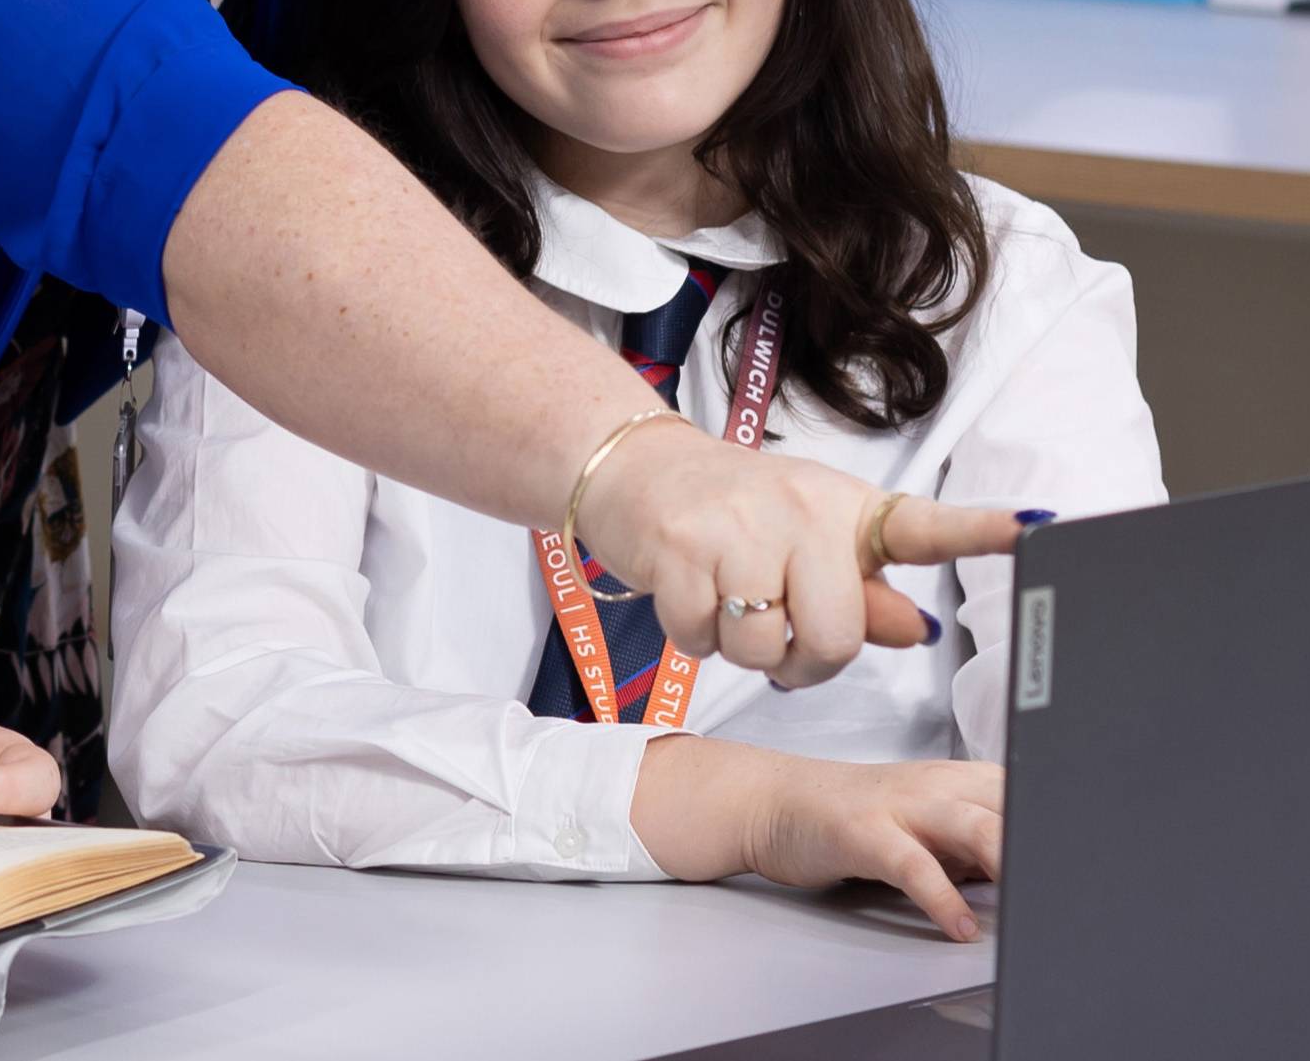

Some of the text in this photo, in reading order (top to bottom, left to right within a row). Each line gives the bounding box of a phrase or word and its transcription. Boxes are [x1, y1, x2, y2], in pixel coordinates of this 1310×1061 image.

[745, 290, 783, 405] DULWICH
[570, 624, 596, 658] HS
[670, 650, 691, 676] S
